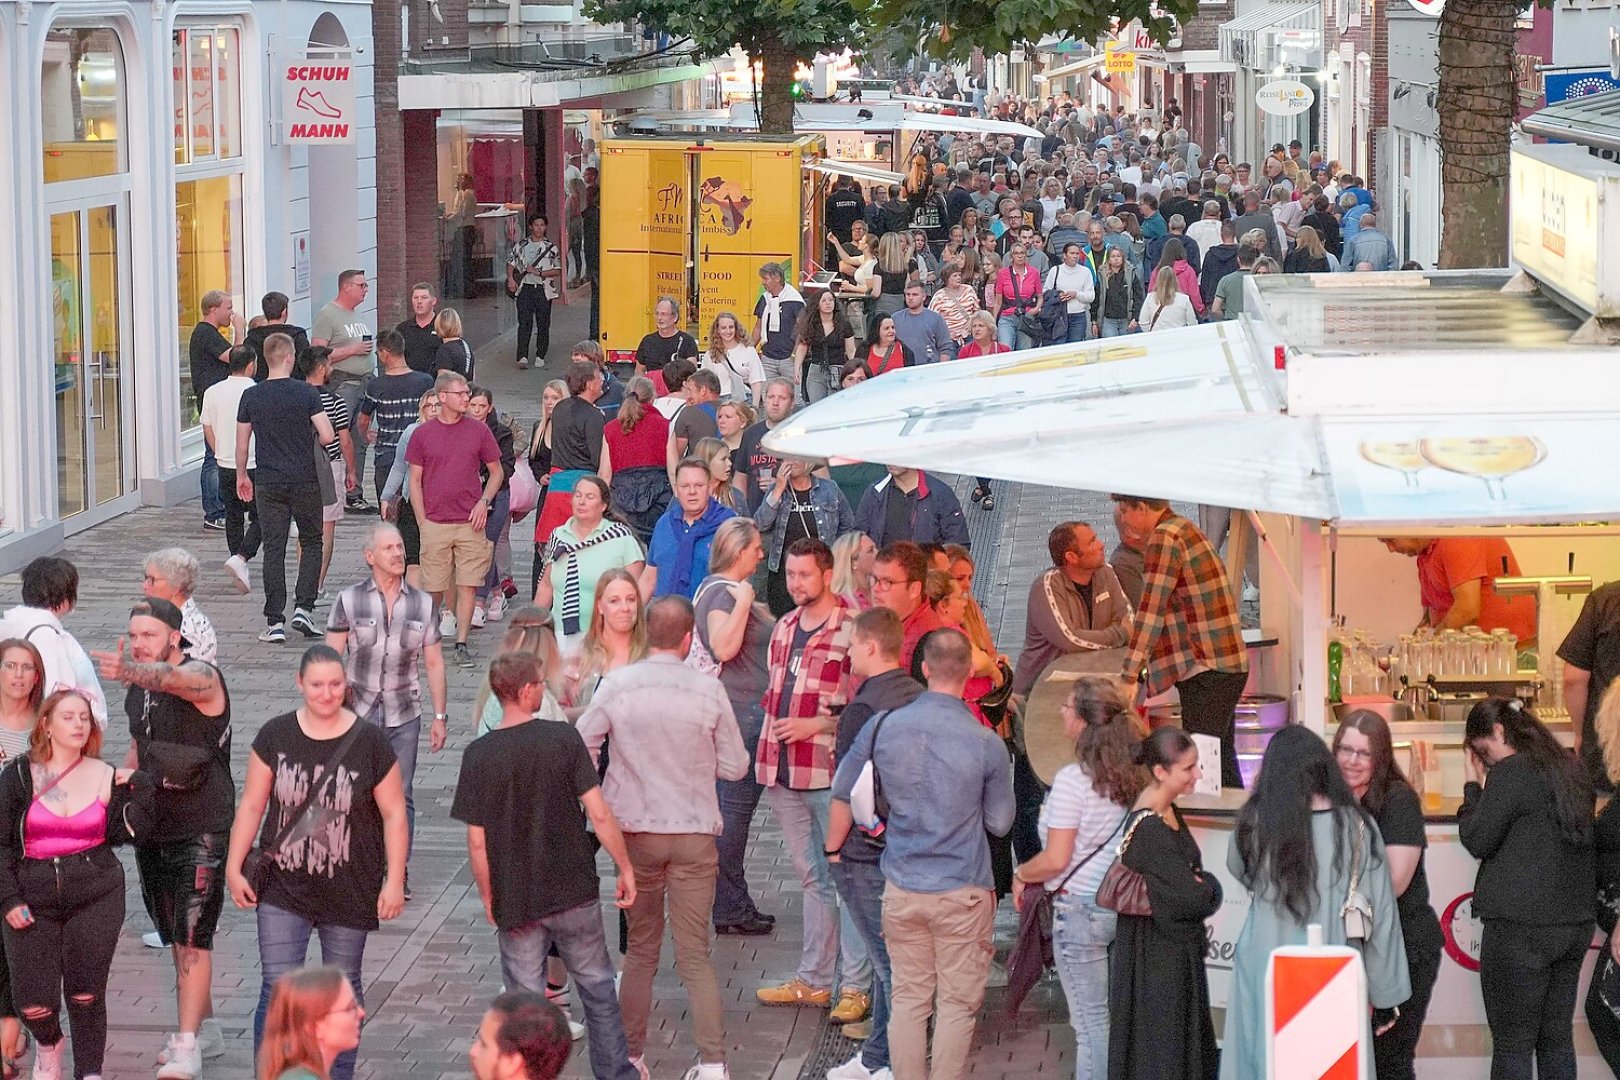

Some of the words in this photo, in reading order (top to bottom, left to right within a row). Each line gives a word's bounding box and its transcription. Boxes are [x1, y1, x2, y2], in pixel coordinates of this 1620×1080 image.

[286, 66, 350, 81] SCHUH
[289, 123, 349, 138] MANN
[640, 224, 683, 234] International
[702, 225, 733, 234] Imbiss
[703, 271, 732, 281] FOOD
[702, 296, 737, 306] Catering
